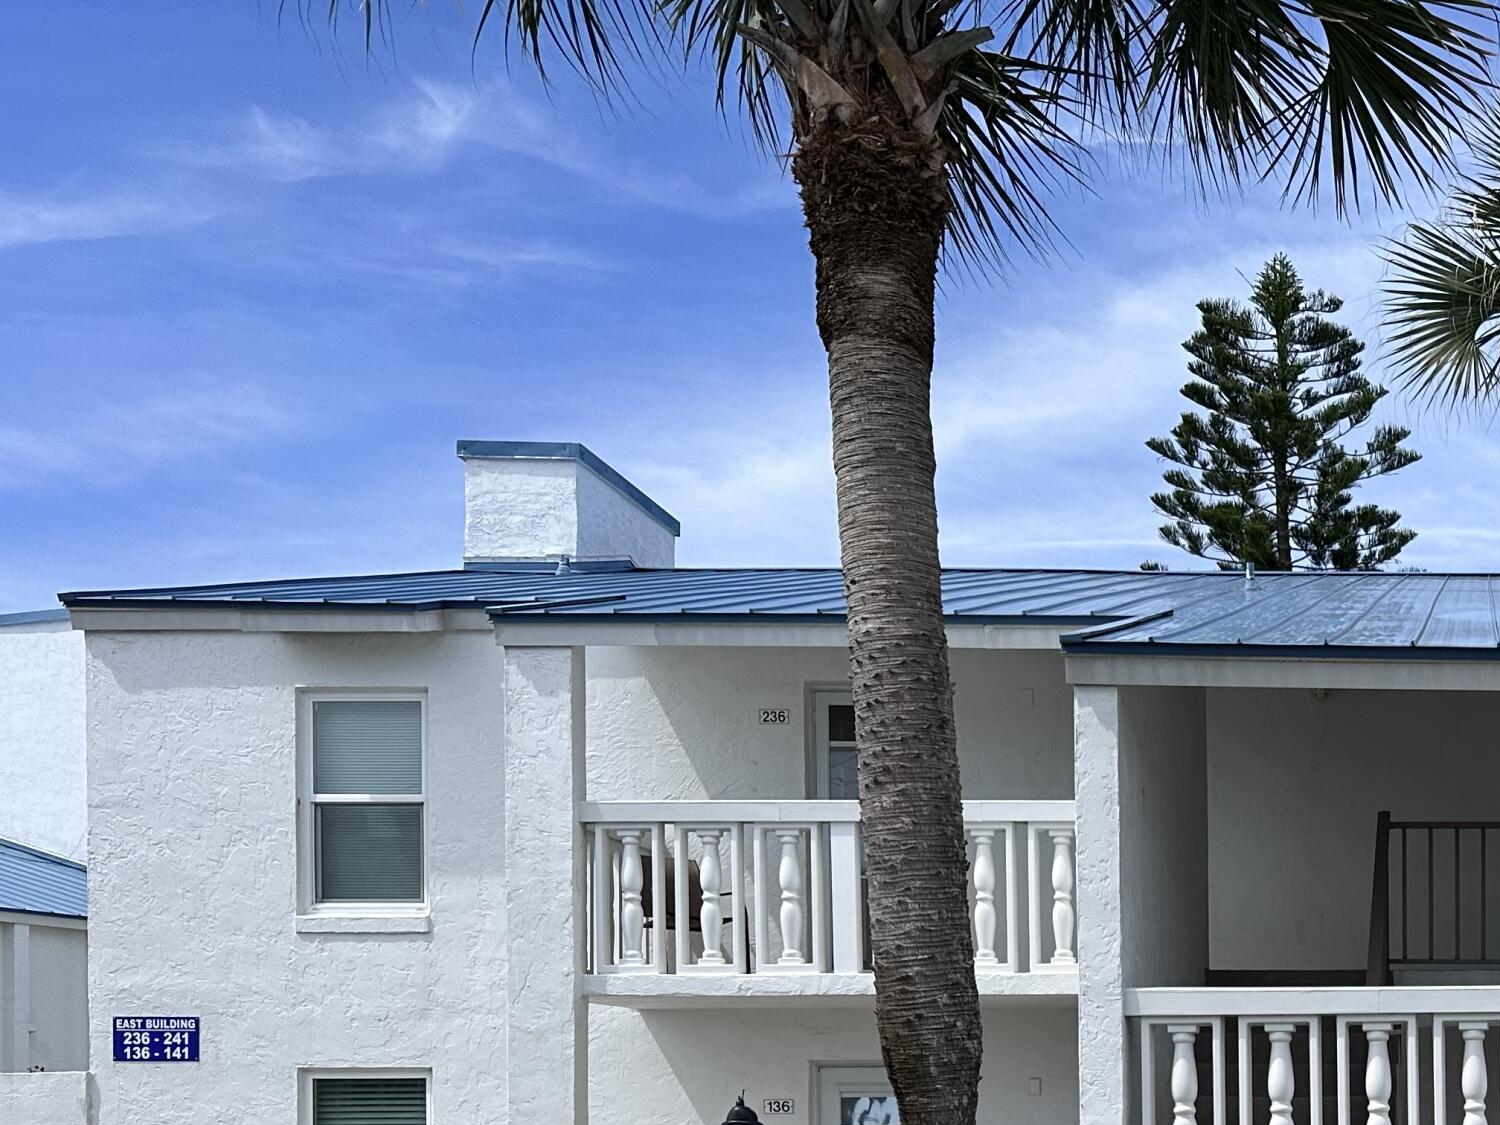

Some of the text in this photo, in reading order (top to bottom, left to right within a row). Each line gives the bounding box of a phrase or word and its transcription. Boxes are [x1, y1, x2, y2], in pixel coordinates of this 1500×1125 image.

[762, 710, 786, 723] 236
[115, 1018, 196, 1029] EAST BUILDING
[123, 1032, 150, 1045] 236
[163, 1032, 189, 1045] 241
[123, 1046, 150, 1060] 136
[163, 1046, 189, 1060] 141
[767, 1100, 790, 1113] 136
